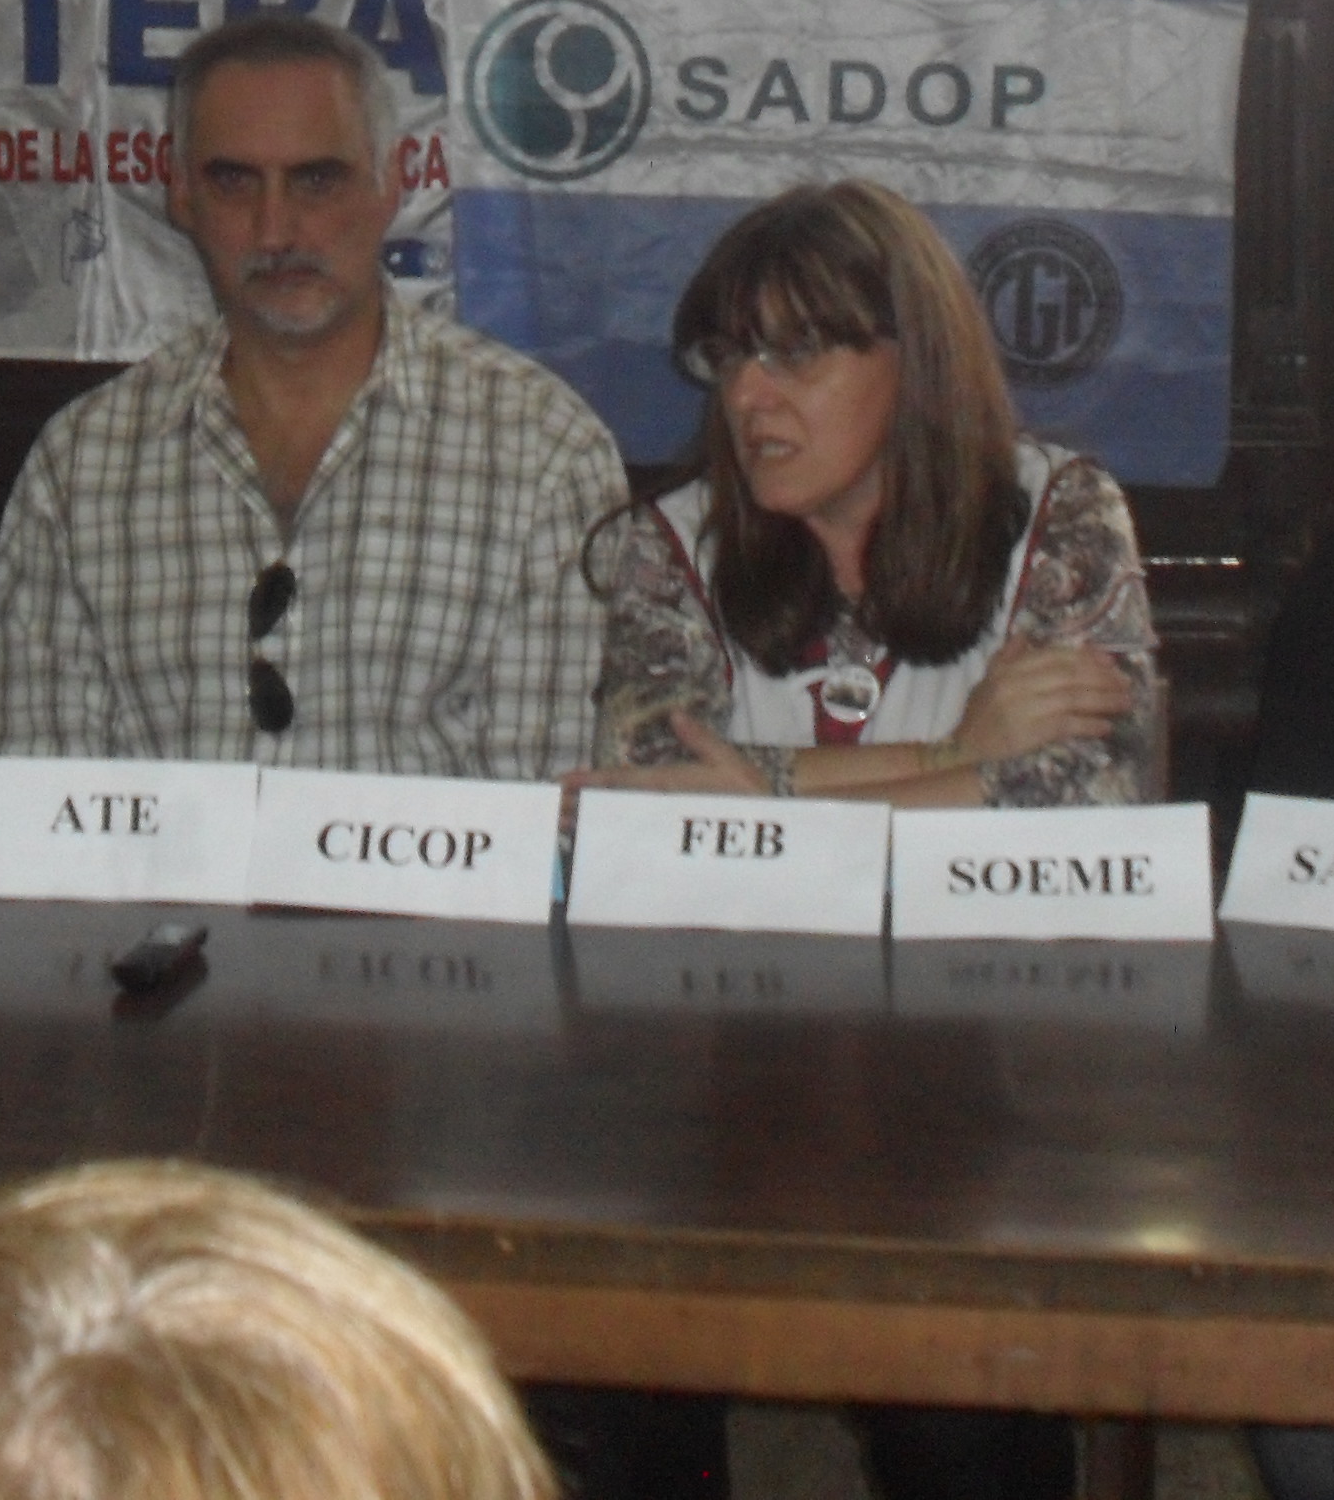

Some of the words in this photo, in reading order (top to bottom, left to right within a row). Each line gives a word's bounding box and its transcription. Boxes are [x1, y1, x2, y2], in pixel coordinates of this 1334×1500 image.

[676, 55, 1049, 131] SADOP
[51, 128, 95, 184] LA
[50, 792, 162, 838] ATE
[678, 816, 787, 861] FEB
[315, 818, 494, 871] CICOP
[947, 854, 1157, 898] SOEME
